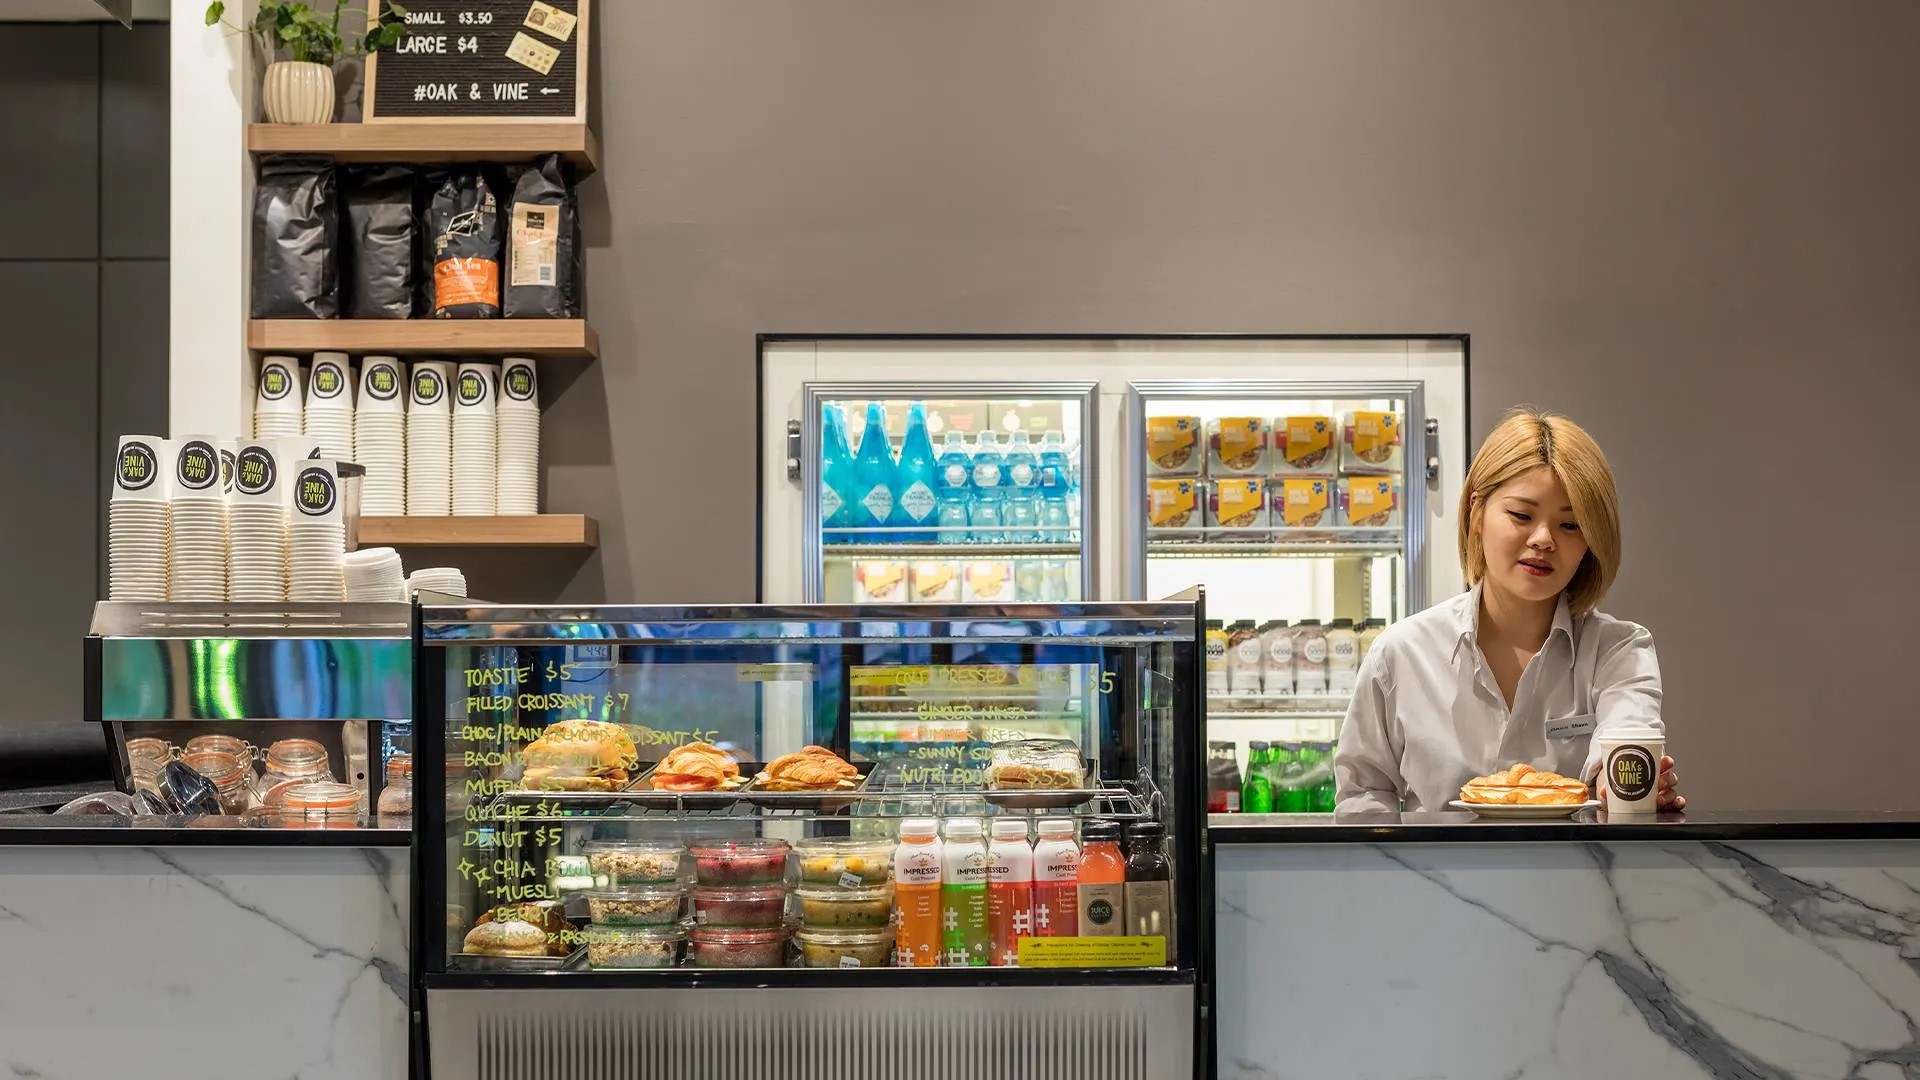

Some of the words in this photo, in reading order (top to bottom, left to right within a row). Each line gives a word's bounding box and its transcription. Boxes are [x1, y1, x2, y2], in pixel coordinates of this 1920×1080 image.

[404, 12, 445, 24] SMALL
[459, 12, 493, 24] $3.50
[396, 36, 447, 54] LARGE
[458, 36, 478, 54] $4
[414, 83, 458, 101] #OAK
[469, 83, 481, 100] &
[493, 83, 529, 100] VINE
[125, 455, 145, 467] VINE
[186, 455, 206, 469] VINE
[244, 461, 263, 474] VINE
[305, 482, 325, 494] VINE
[545, 661, 578, 681] $5
[466, 695, 512, 714] FILLED
[518, 693, 596, 713] CROISSANT
[614, 729, 690, 747] OISSANT
[465, 751, 511, 768] BACON
[901, 768, 947, 785] NUTRI
[1618, 772, 1643, 785] VINE
[464, 804, 531, 822] QUICHE
[537, 799, 564, 818] $6
[463, 831, 528, 848] DONUT
[536, 826, 563, 847] $5
[493, 859, 536, 878] CHIA
[903, 866, 941, 876] IMPRESSED
